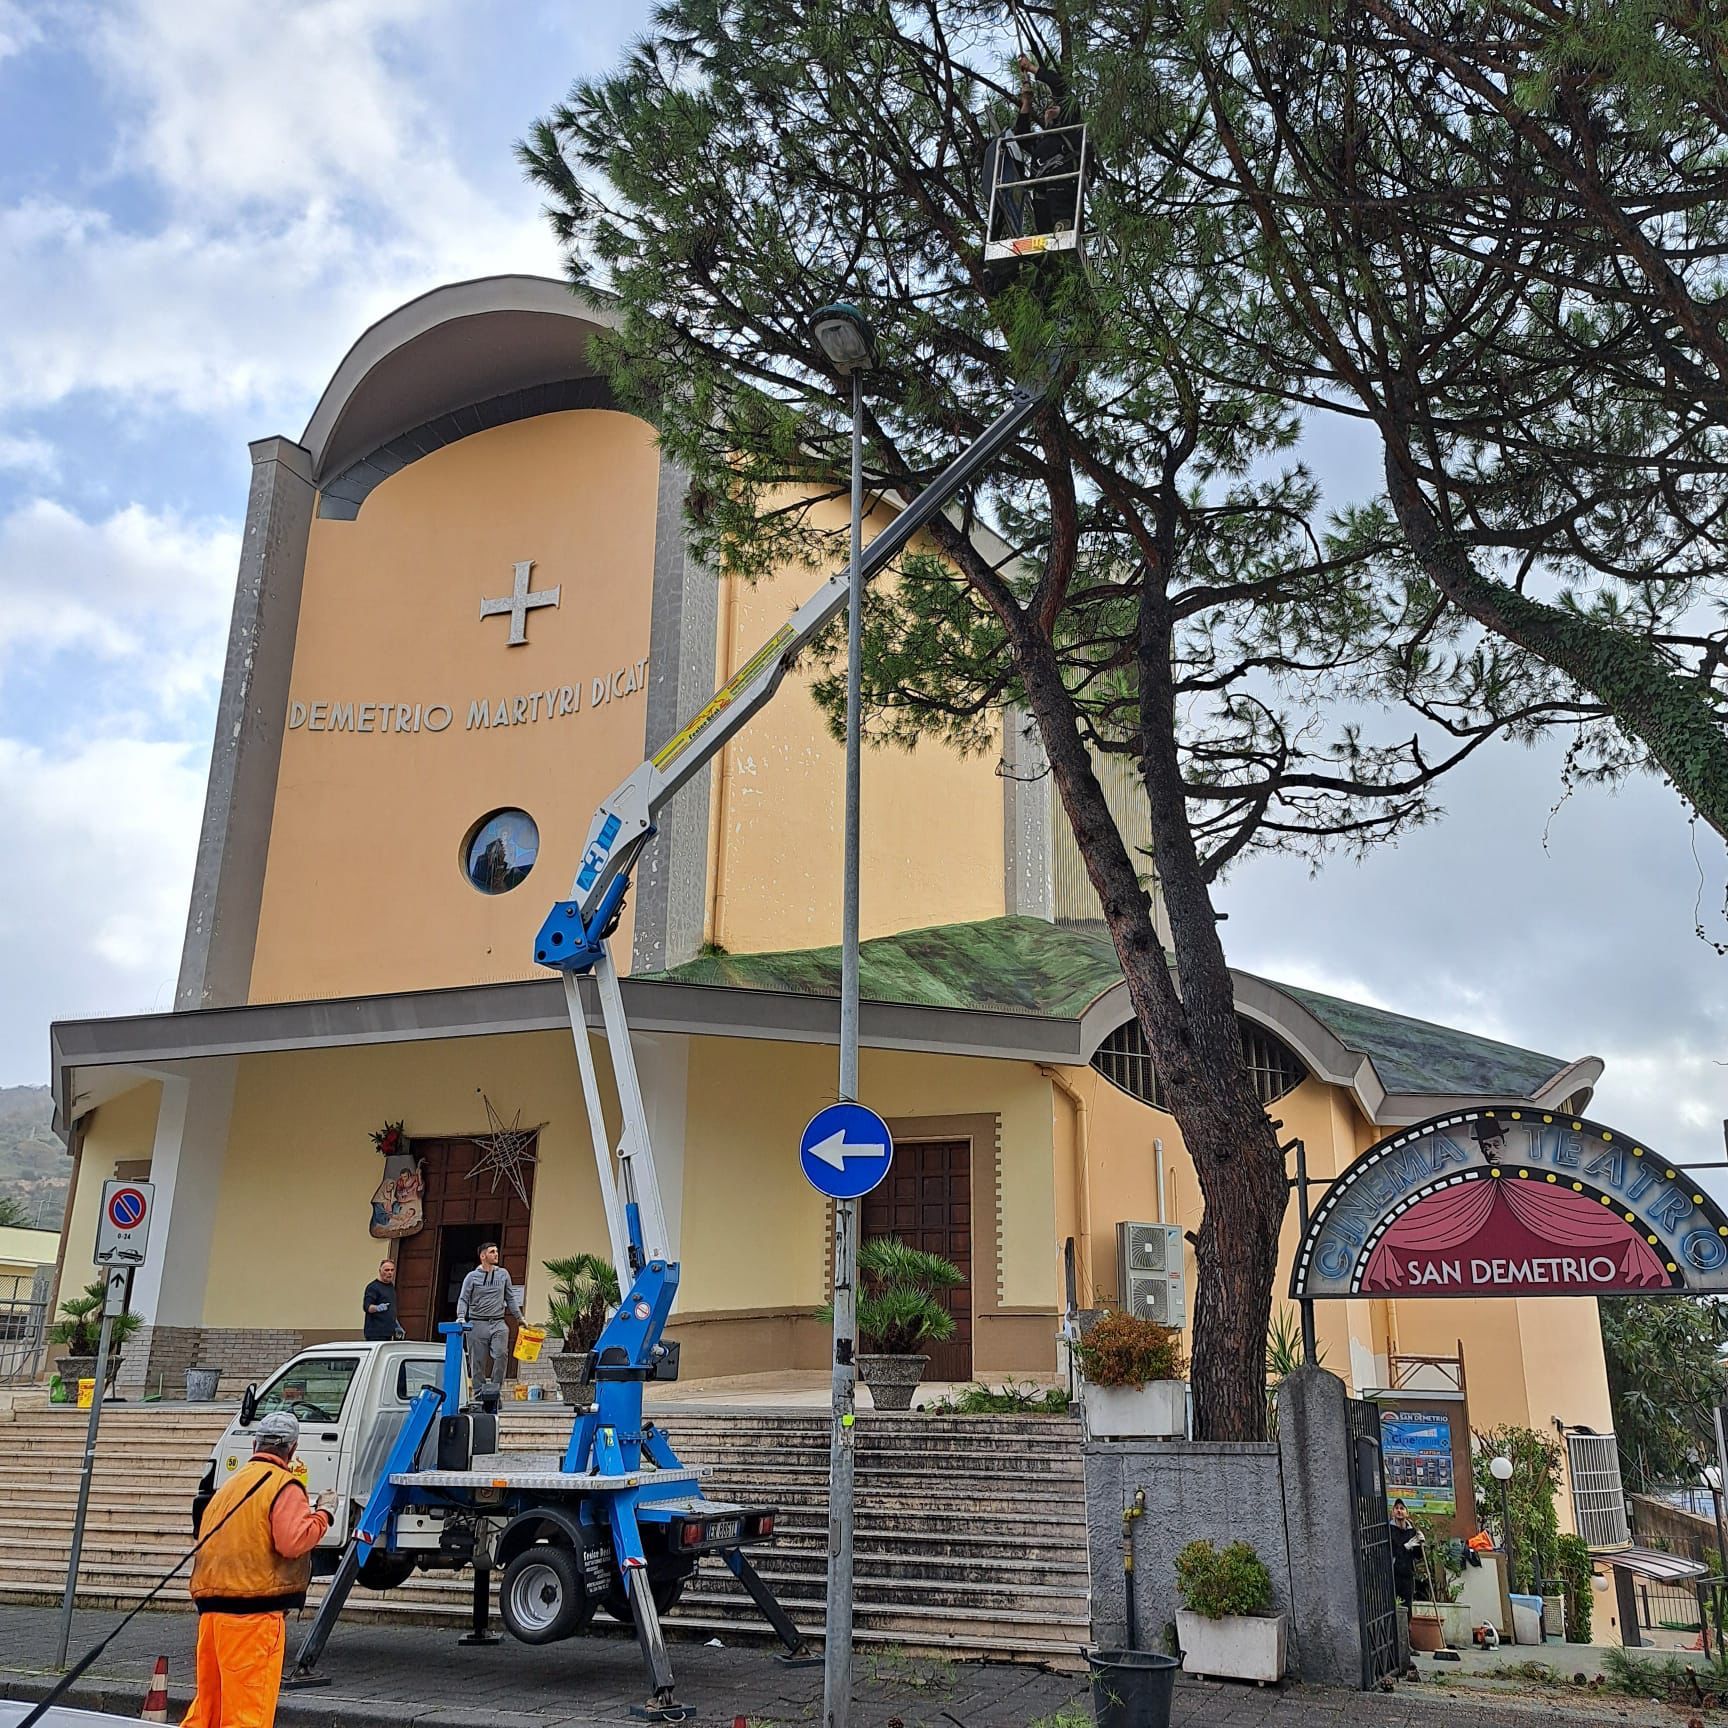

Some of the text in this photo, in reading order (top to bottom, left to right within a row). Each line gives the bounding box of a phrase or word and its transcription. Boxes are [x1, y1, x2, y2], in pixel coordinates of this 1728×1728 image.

[288, 657, 650, 733] DEMETRIO MARTYRI DICAT
[1312, 1122, 1728, 1280] CINEMA TEATRO
[1408, 1256, 1616, 1286] SAN DEMETRIO
